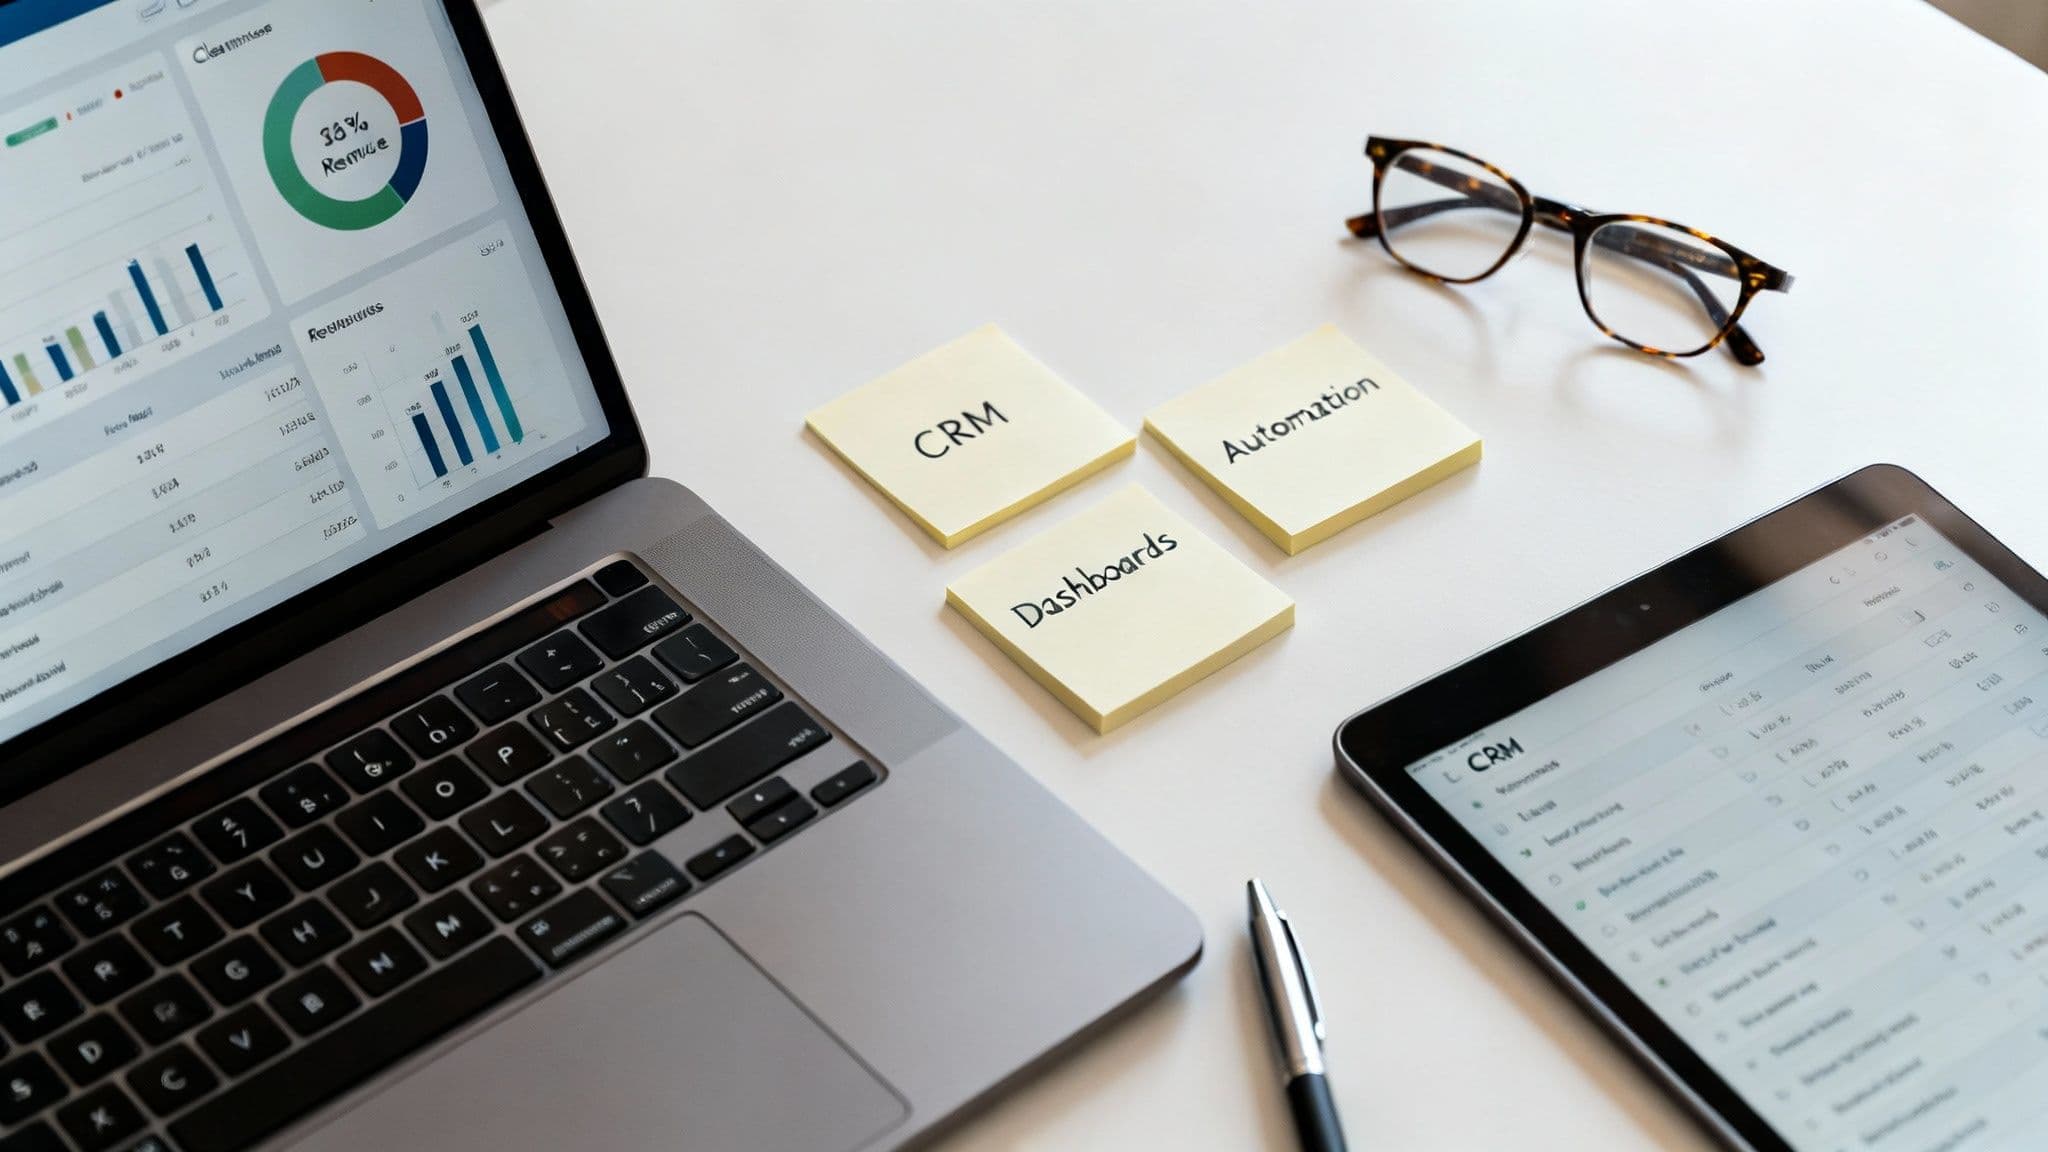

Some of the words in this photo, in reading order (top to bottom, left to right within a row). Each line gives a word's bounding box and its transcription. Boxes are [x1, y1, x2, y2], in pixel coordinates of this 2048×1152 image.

[915, 402, 1008, 458] CRM
[1223, 379, 1379, 464] Automation
[1011, 533, 1177, 628] Dashboards
[498, 747, 513, 763] P
[1467, 736, 1525, 772] CRM
[492, 821, 513, 835] L
[303, 850, 324, 868] U
[426, 853, 447, 870] K
[164, 922, 183, 939] T
[230, 1030, 250, 1048] V
[79, 1042, 101, 1063] D
[161, 1070, 185, 1089] C
